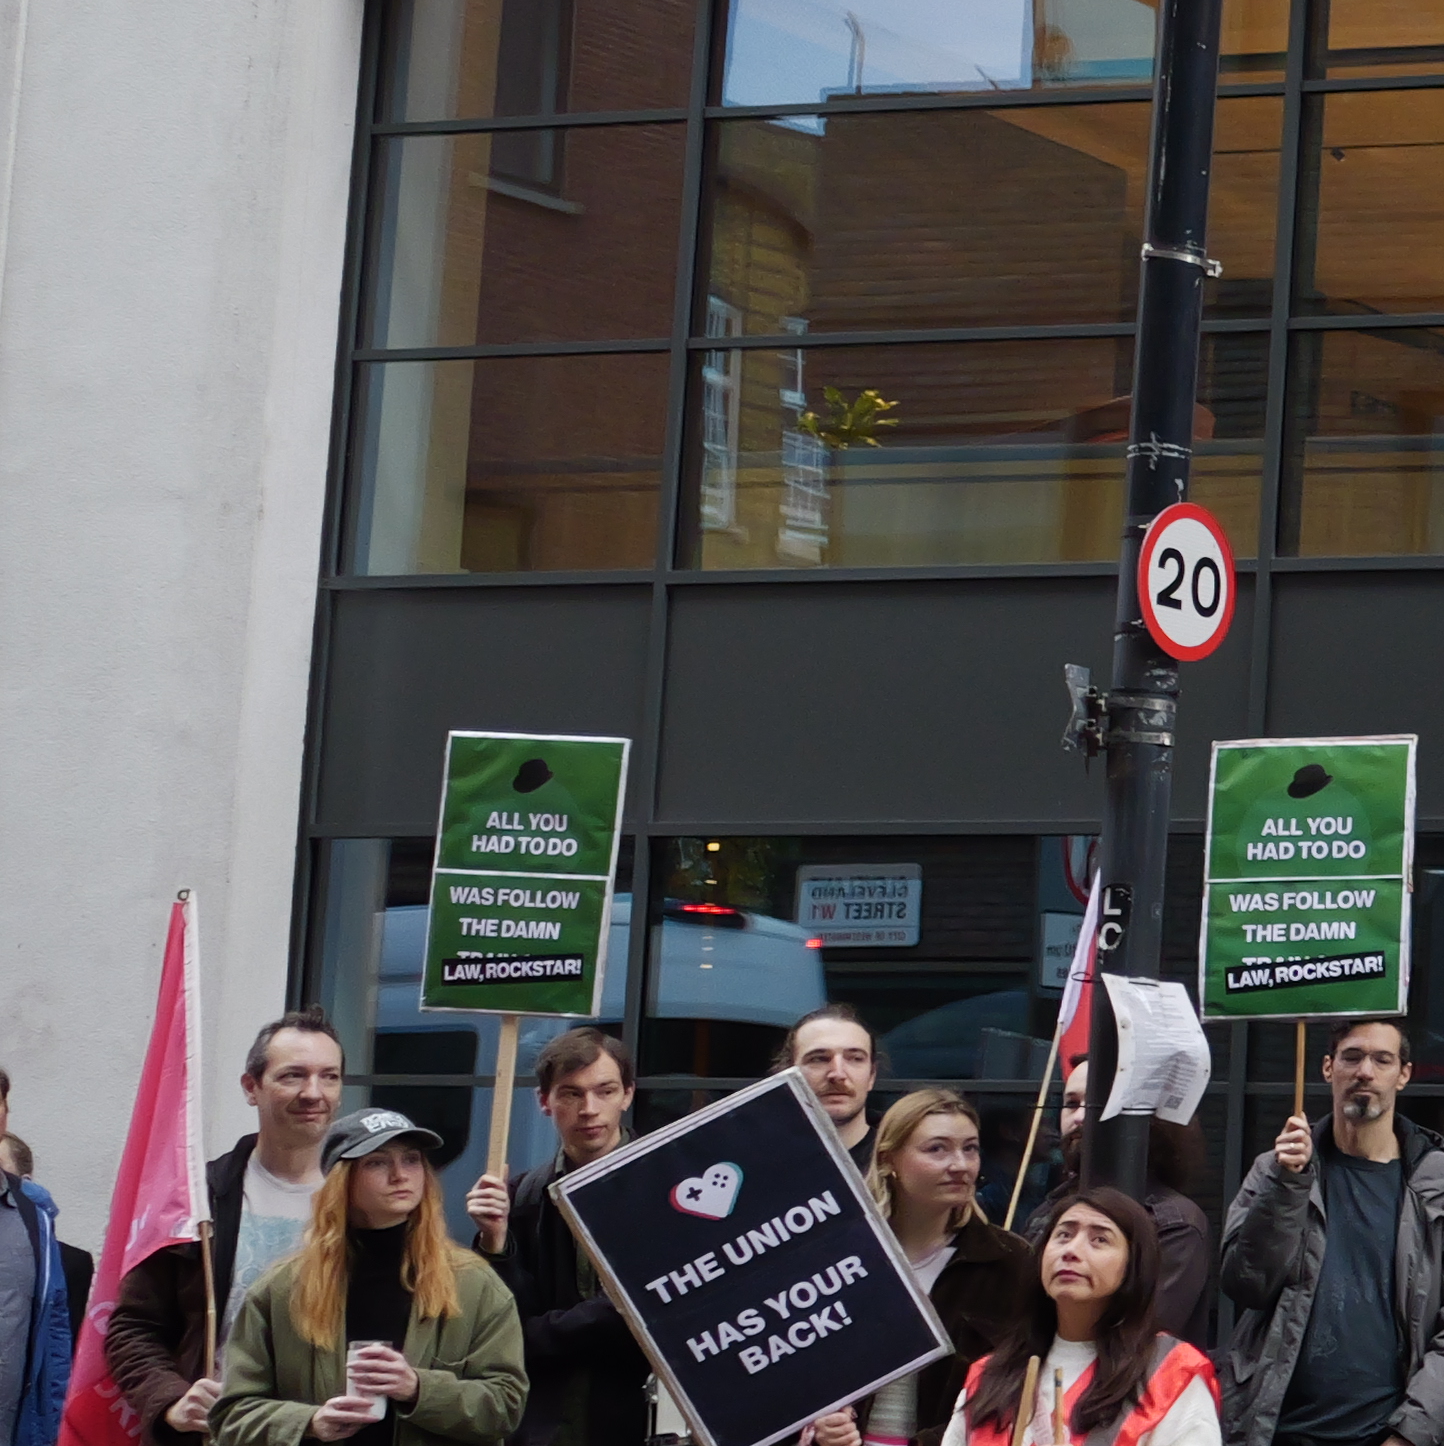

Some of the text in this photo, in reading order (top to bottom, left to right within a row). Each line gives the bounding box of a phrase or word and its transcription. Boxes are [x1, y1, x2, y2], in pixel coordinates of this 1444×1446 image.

[1156, 547, 1221, 618] 20
[486, 811, 568, 832] ALL YOU
[1261, 816, 1353, 836] ALL YOU
[471, 834, 579, 857] HAD TO DO
[1246, 840, 1366, 861] HAD TO DO
[449, 885, 580, 910] WAS FOLLOW
[1229, 889, 1376, 913] WAS FOLLOW
[458, 917, 561, 941] THE DAMN
[1242, 921, 1356, 943] THE DAMN
[443, 958, 582, 983] LAW, ROCKSTAR!
[1227, 955, 1384, 990] LAW, ROCKSTAR!
[644, 1190, 842, 1305] THE UNION
[685, 1255, 869, 1363] HAS YOUR
[738, 1300, 853, 1375] BACK!
